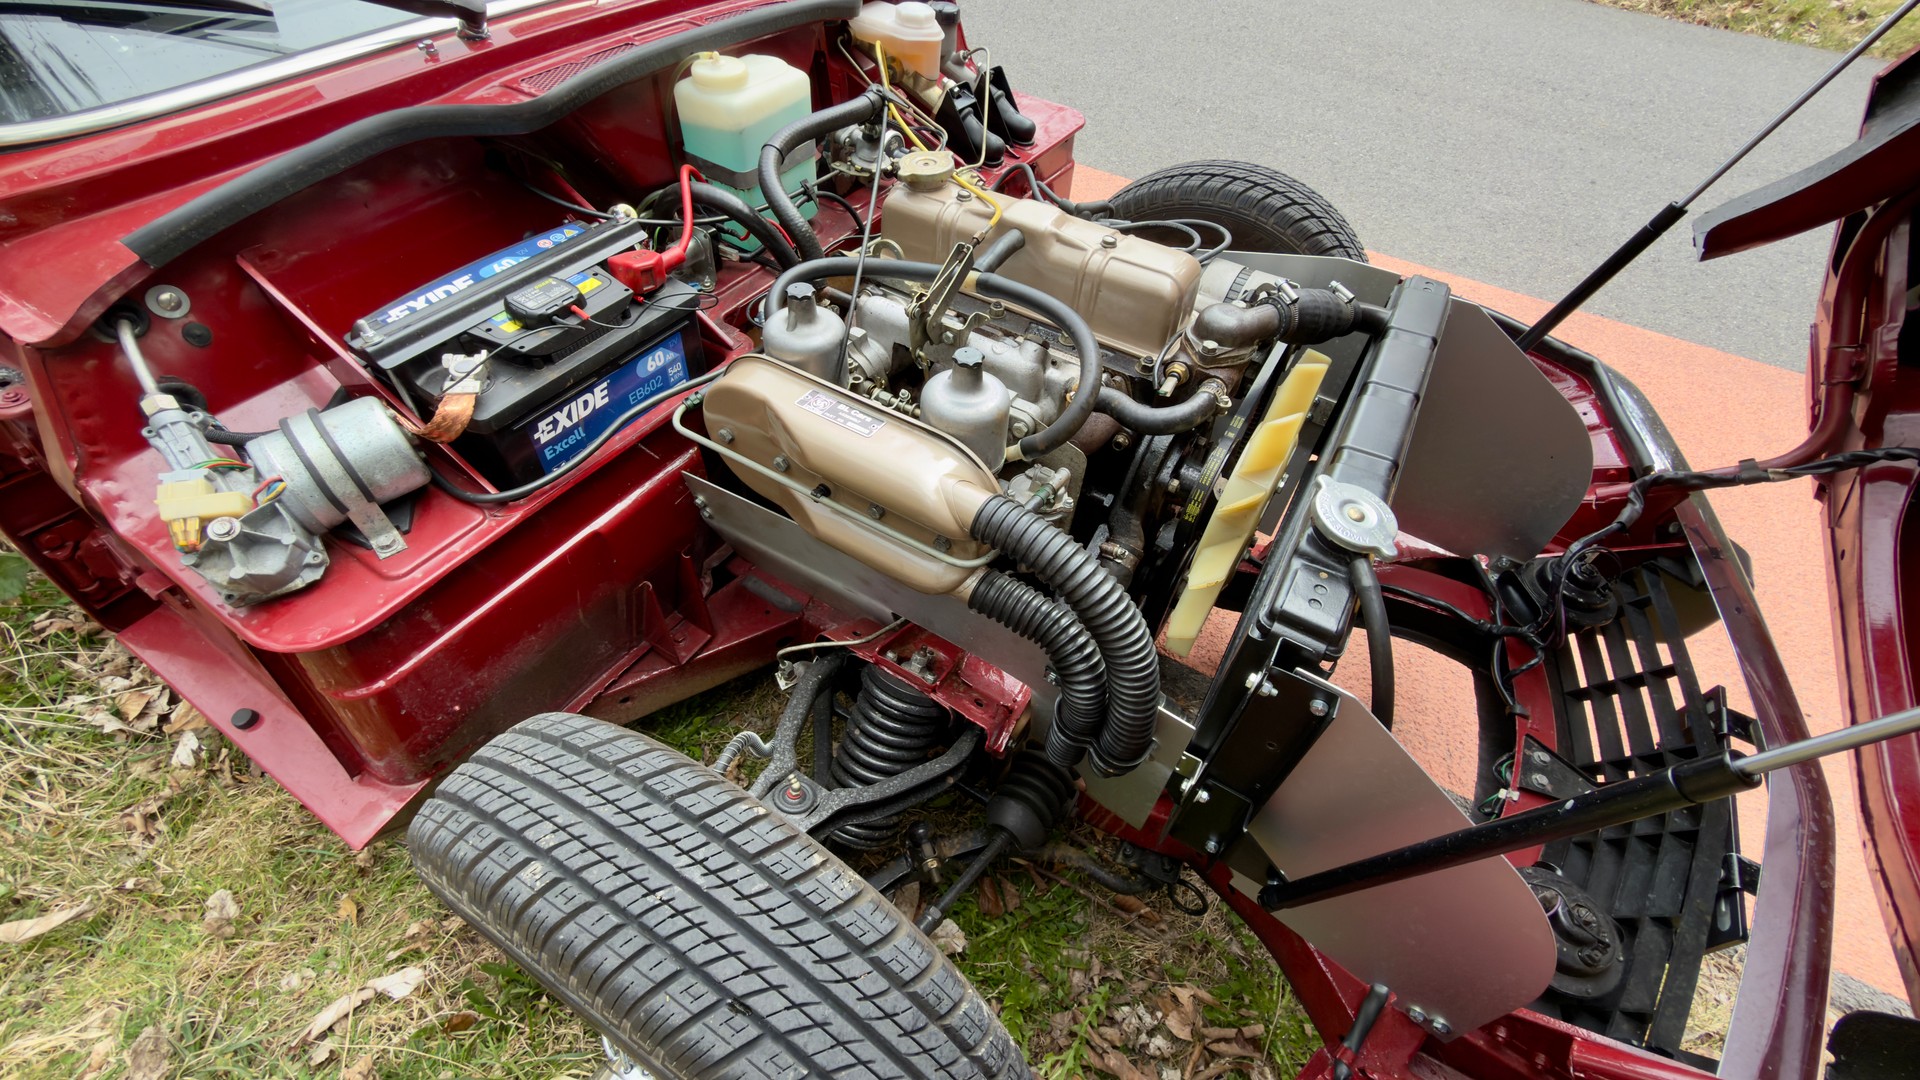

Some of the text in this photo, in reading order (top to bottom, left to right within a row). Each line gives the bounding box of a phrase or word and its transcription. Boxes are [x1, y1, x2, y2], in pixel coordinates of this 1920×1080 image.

[646, 350, 665, 372] 60
[667, 362, 682, 377] 540
[628, 375, 664, 405] EB602
[534, 380, 610, 444] EXIDE
[543, 426, 586, 461] Excell
